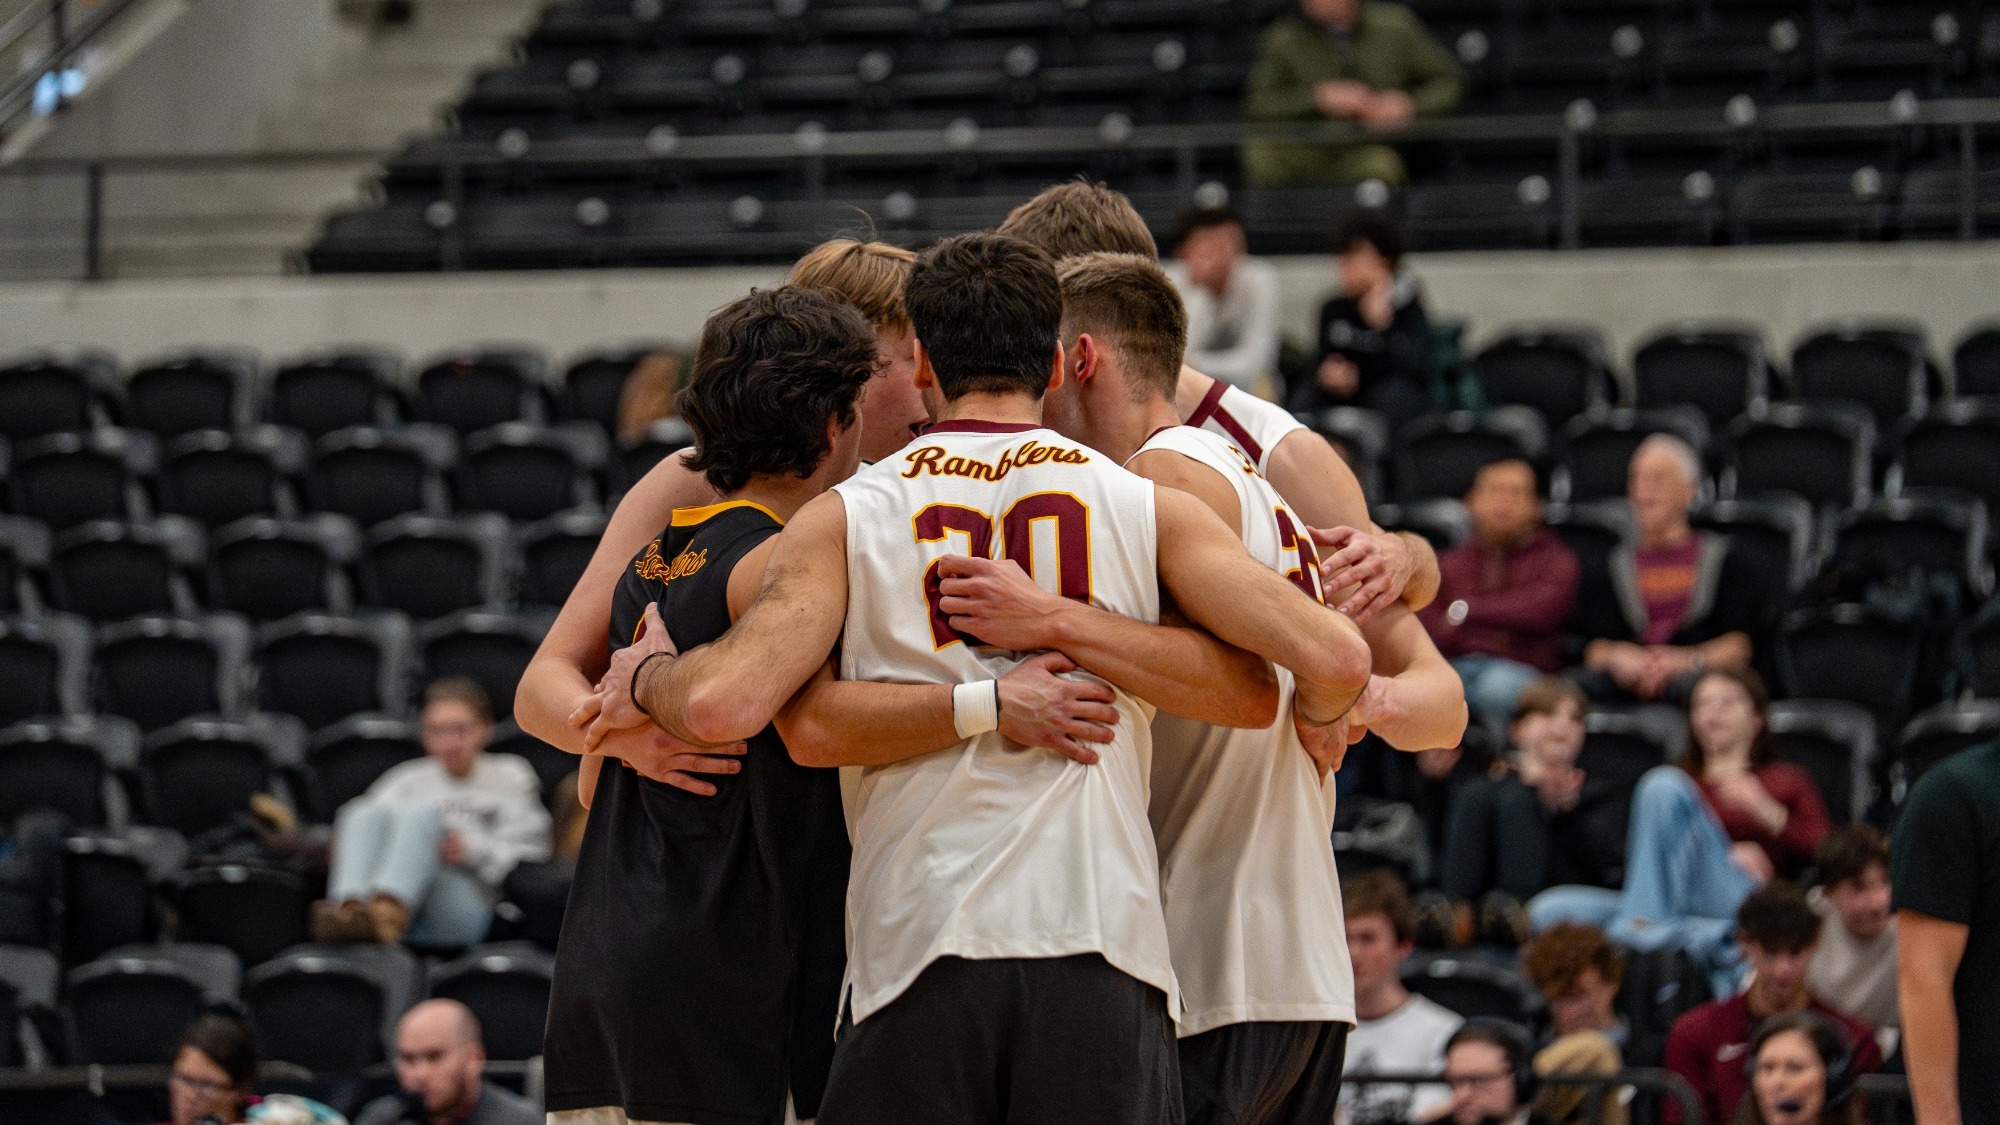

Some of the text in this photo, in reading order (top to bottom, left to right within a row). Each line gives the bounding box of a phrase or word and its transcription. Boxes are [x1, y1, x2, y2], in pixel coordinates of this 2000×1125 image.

[900, 440, 1090, 482] Ramblers
[635, 539, 708, 586] Raers
[912, 490, 1094, 652] 20
